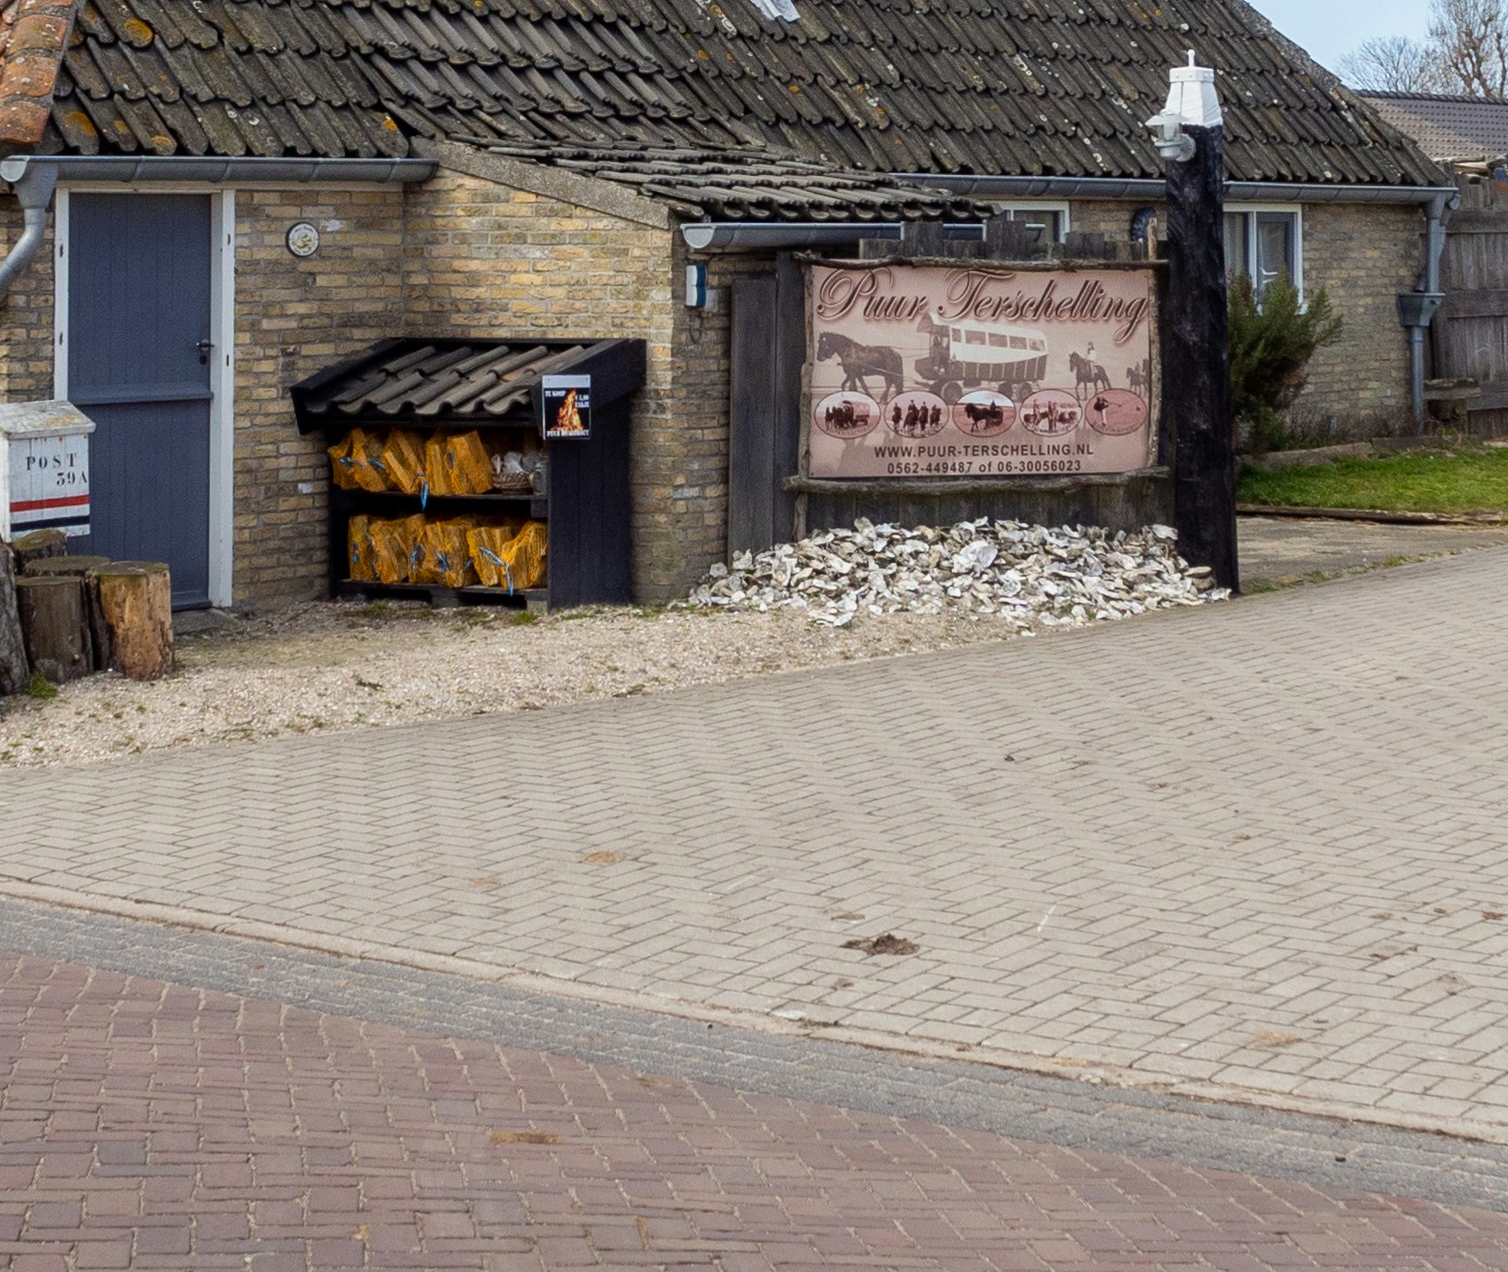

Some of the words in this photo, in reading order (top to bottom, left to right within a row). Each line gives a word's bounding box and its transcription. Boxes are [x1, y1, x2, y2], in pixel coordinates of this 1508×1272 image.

[817, 267, 928, 320] Puur
[938, 268, 1148, 344] Terschelling
[874, 444, 1094, 458] WWW.PUUR-TERSCHELLING.NL
[26, 453, 77, 471] POST
[887, 462, 973, 474] 0562-449487
[978, 462, 992, 473] of
[997, 460, 1081, 472] 06-30056023
